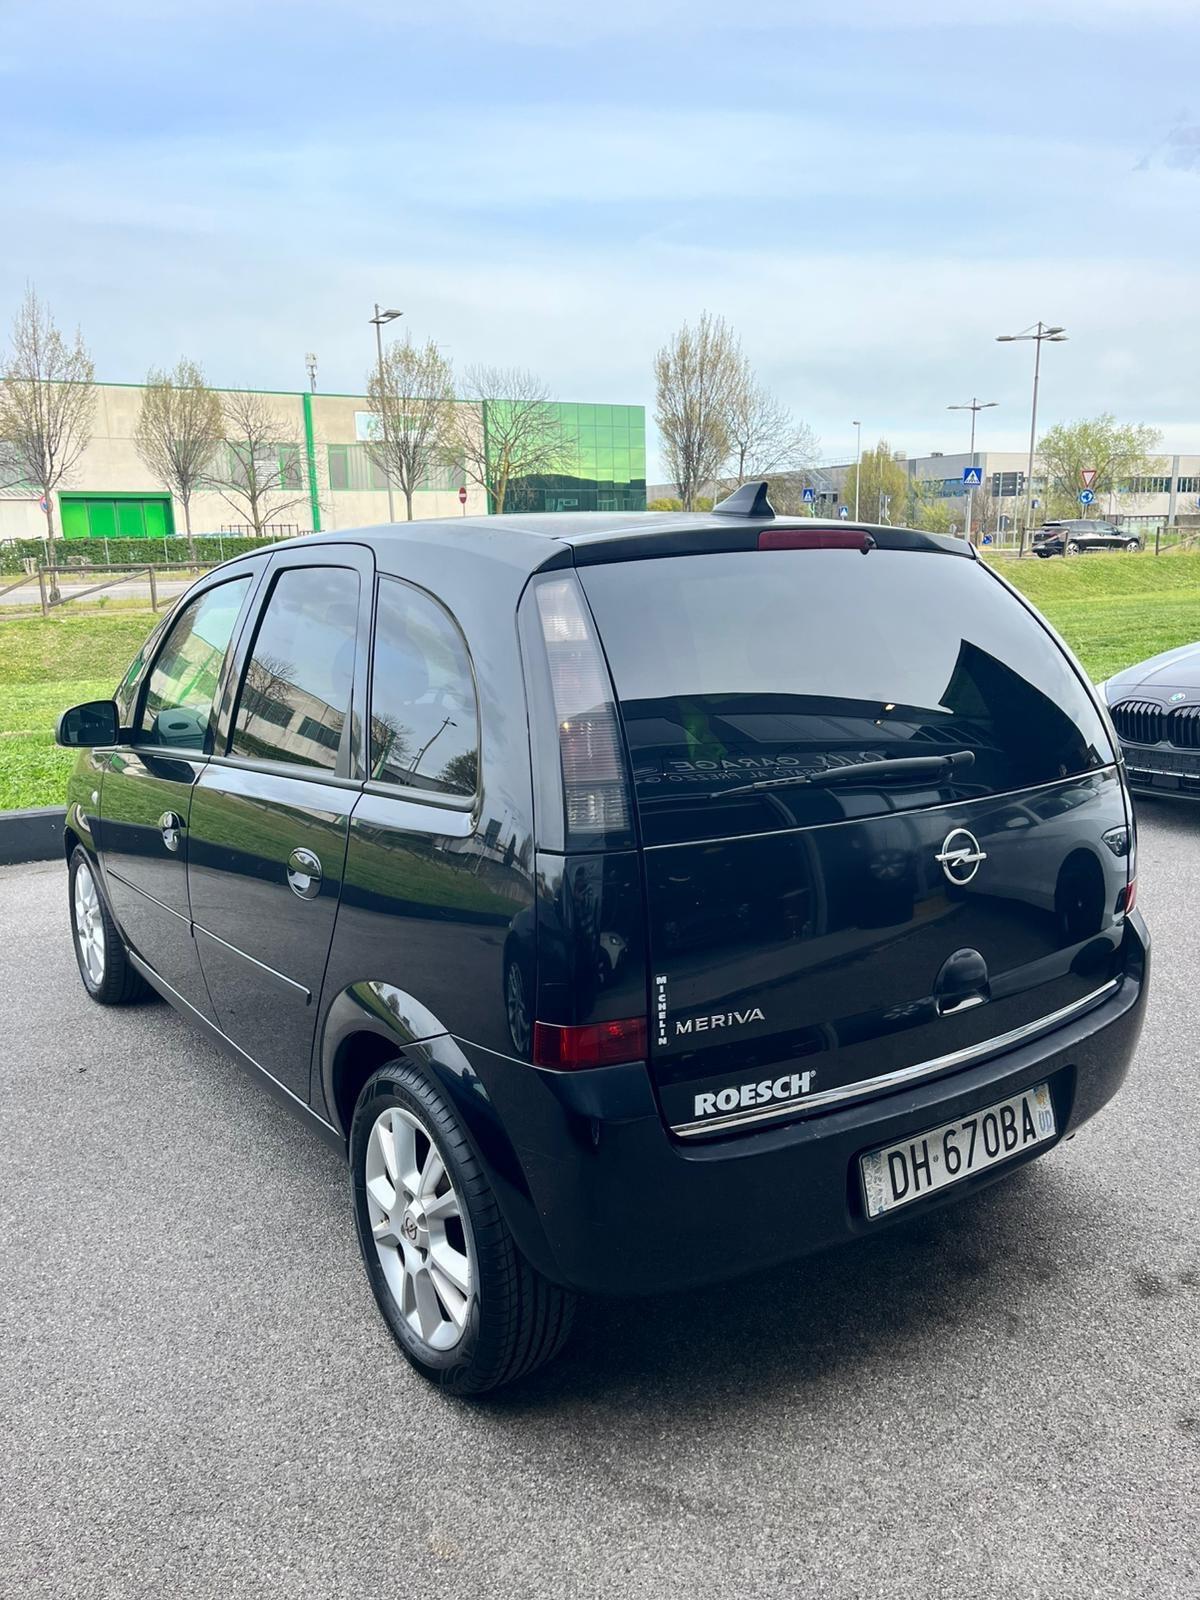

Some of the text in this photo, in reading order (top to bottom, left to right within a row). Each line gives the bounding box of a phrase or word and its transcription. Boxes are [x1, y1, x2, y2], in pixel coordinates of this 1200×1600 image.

[656, 975, 668, 1046] MICHELIN
[887, 1096, 1038, 1201] DH 670BA
